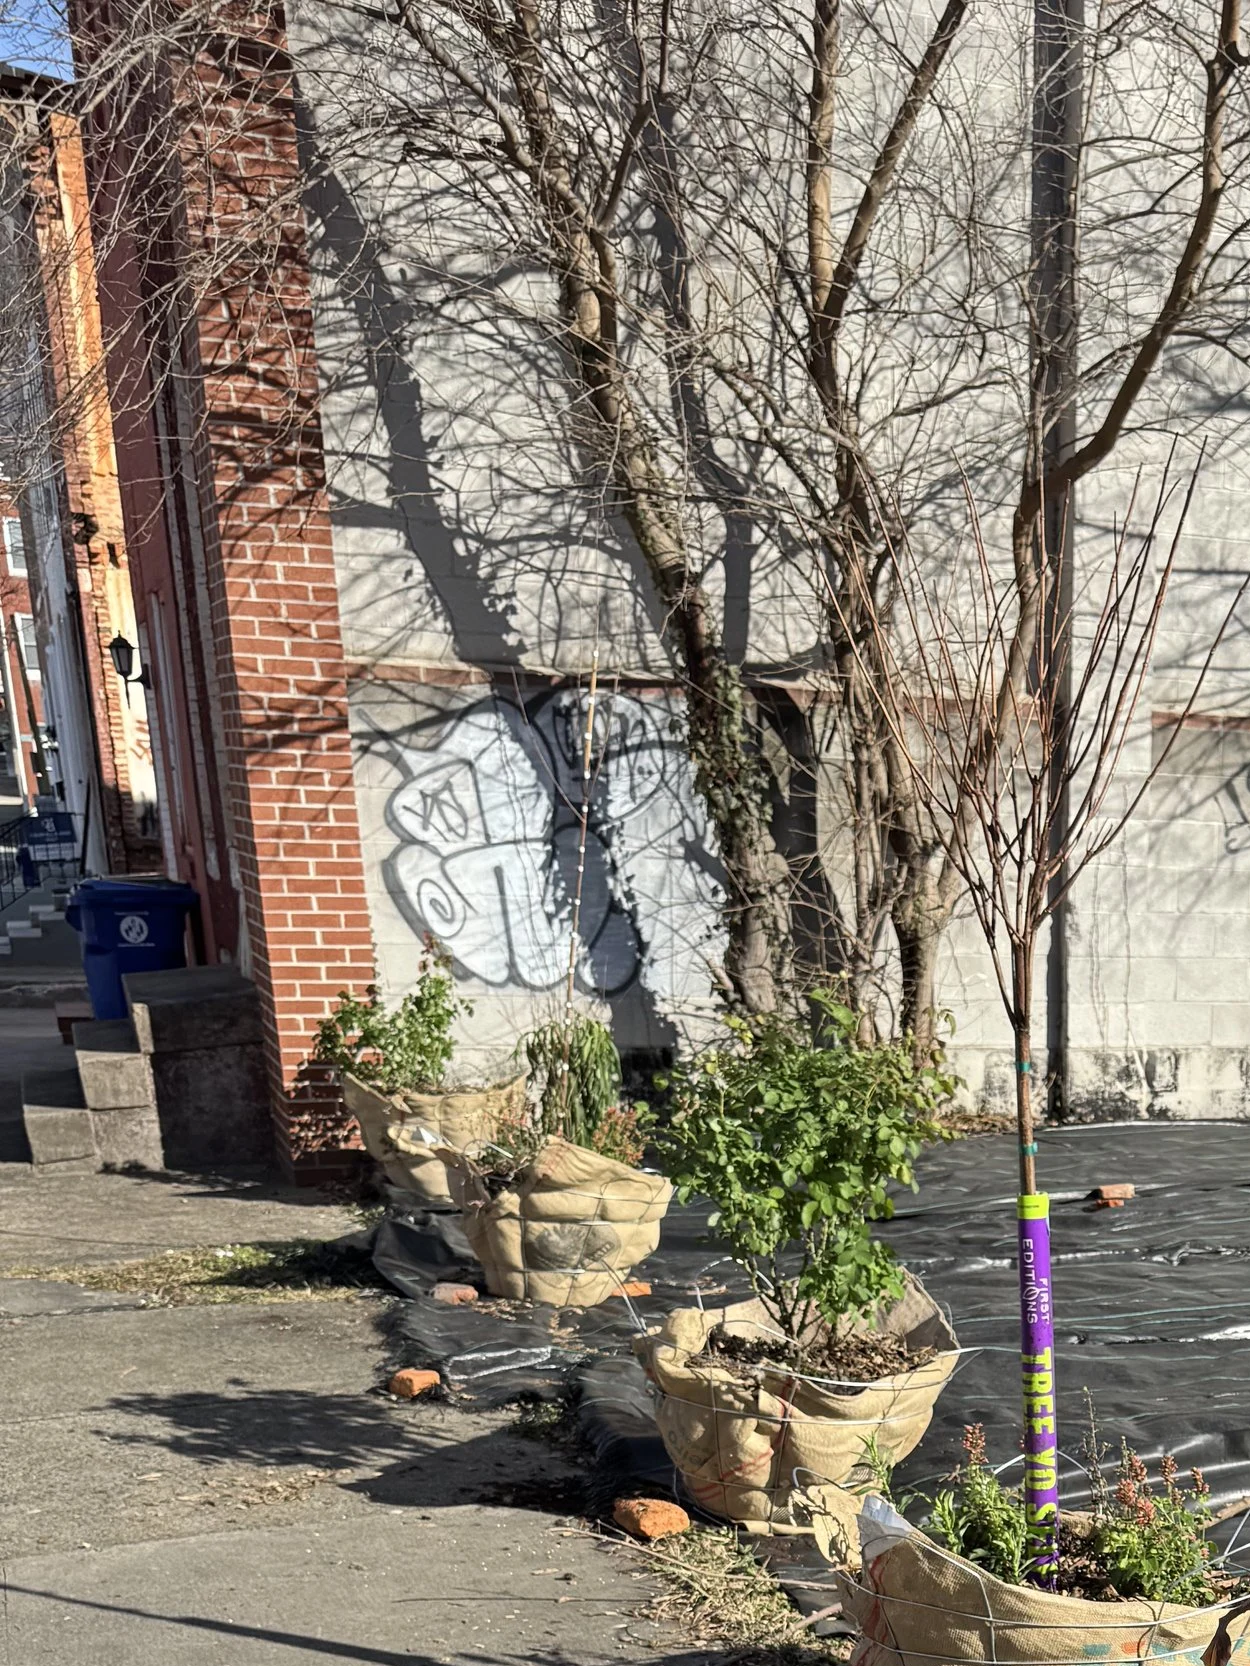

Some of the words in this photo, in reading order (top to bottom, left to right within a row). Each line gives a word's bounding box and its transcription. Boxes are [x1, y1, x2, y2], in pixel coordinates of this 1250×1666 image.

[1022, 1238, 1040, 1325] EDITIONS
[1039, 1278, 1050, 1323] FIRST
[1021, 1347, 1055, 1435] TREE
[1026, 1446, 1057, 1491] YO
